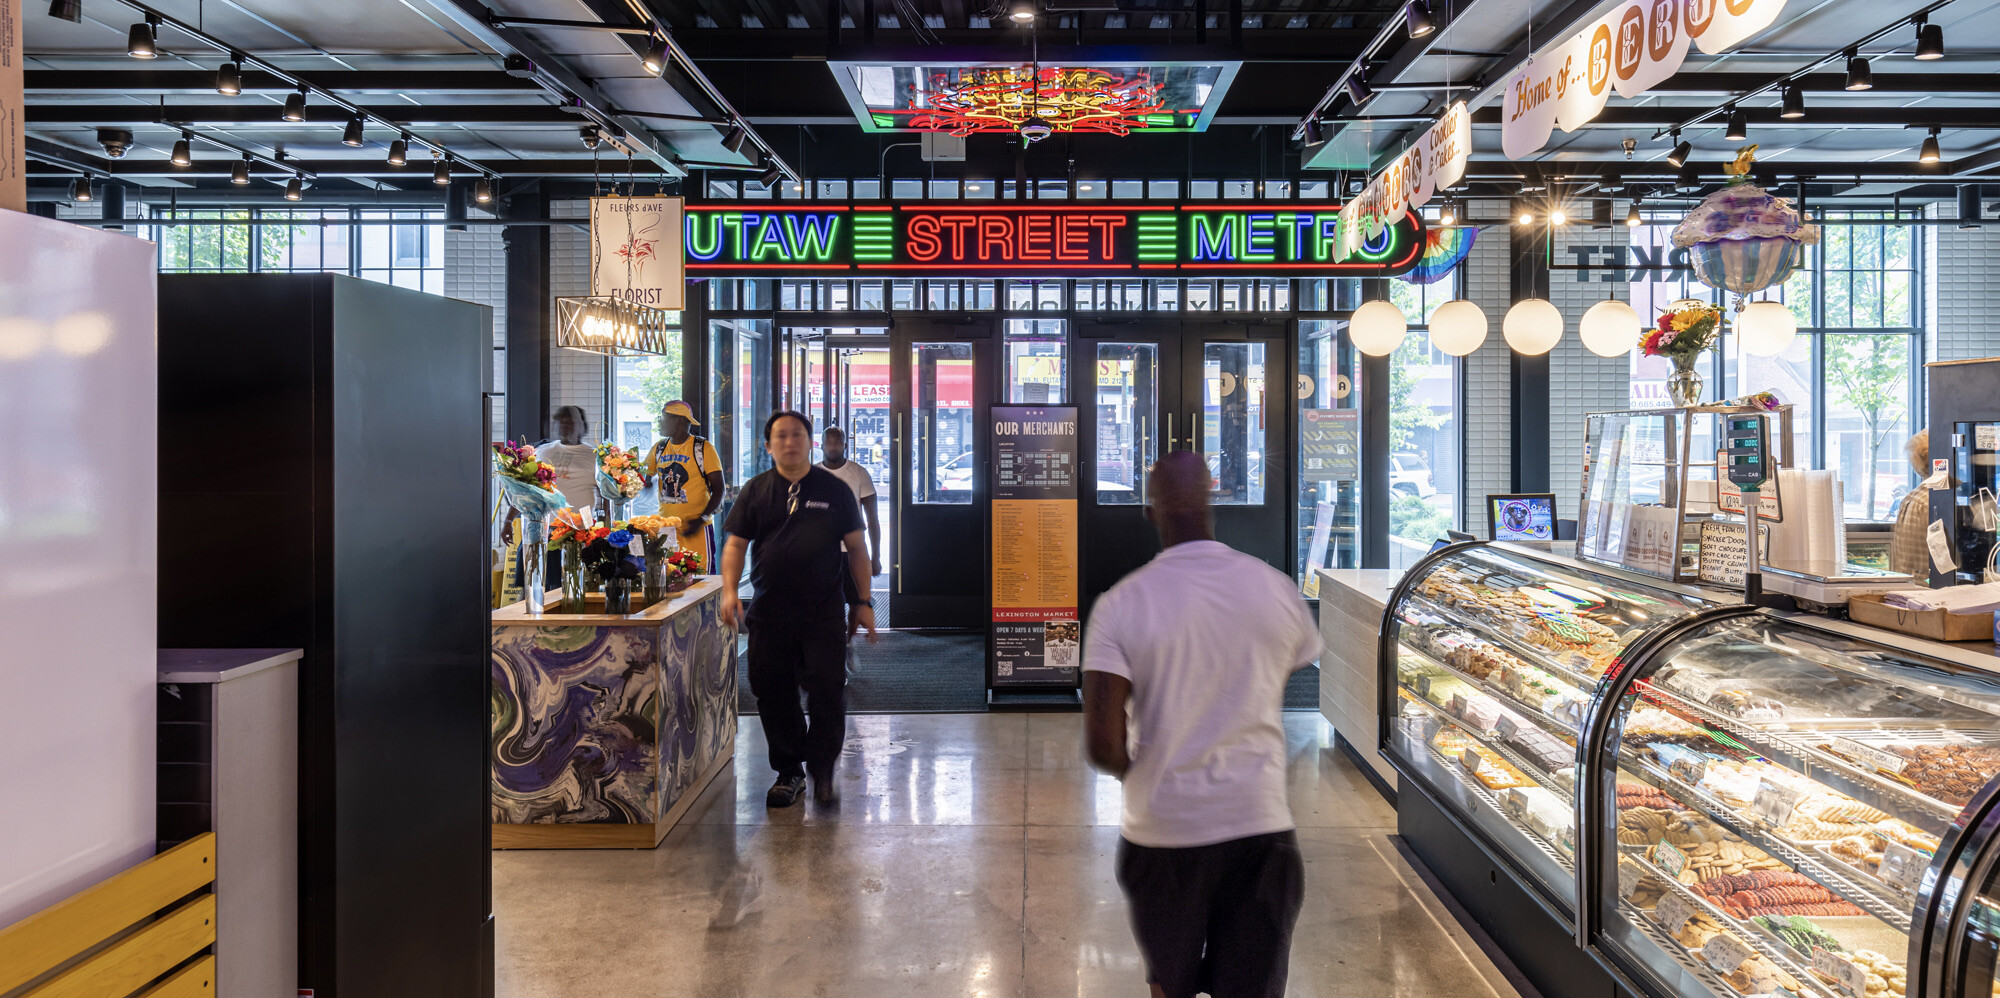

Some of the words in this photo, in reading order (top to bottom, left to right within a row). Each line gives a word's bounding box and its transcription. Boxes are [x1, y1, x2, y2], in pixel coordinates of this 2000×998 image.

[1511, 75, 1551, 123] Home
[1590, 0, 1746, 88] BERG
[1430, 113, 1458, 150] Cookies
[610, 203, 639, 212] FLEURS
[686, 213, 839, 262] UTAW
[906, 214, 1127, 261] STREET
[1112, 377, 1123, 385] 212
[1630, 384, 1672, 399] AILS
[1631, 400, 1675, 408] 0.685.449
[995, 422, 1019, 436] OUR
[1023, 422, 1075, 436] MERCHANTS
[1702, 523, 1720, 534] FRESH
[1727, 561, 1747, 569] CRUNC
